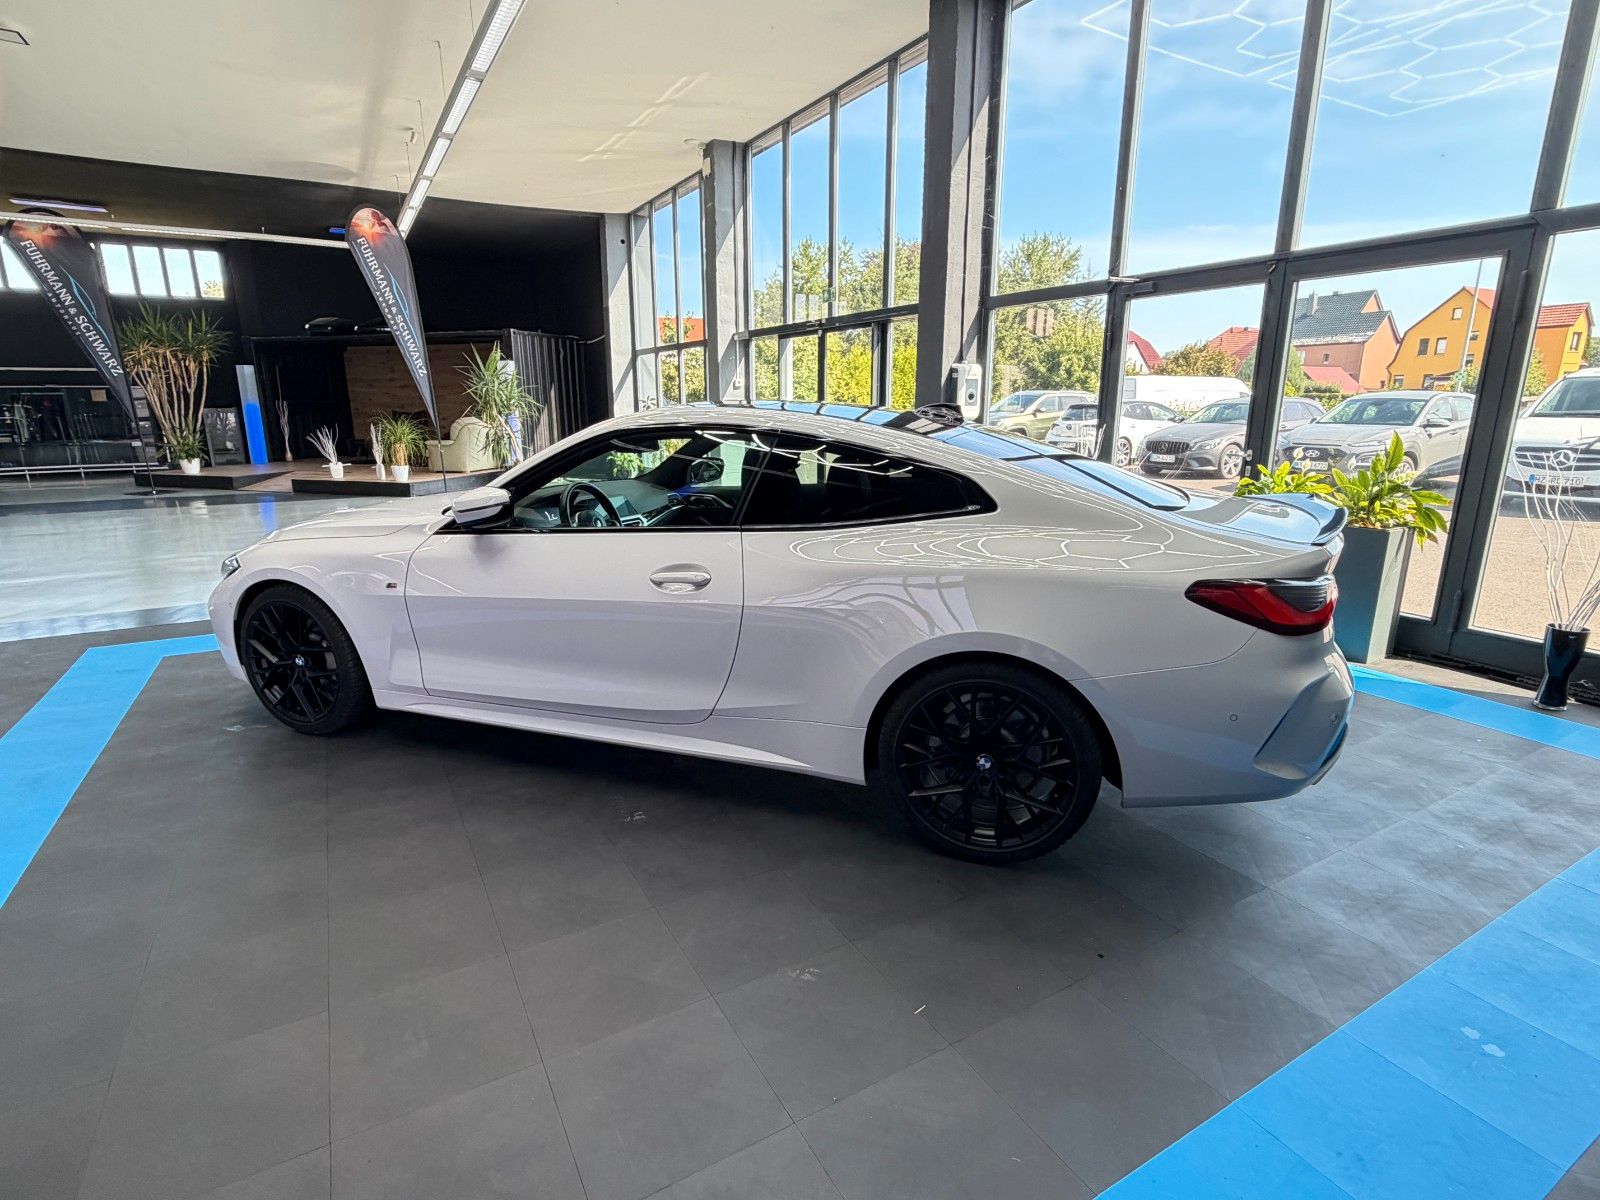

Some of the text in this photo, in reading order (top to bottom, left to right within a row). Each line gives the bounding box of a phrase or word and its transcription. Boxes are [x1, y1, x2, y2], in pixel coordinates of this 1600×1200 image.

[20, 239, 125, 377] FUHRMANN & SCHWARZ
[357, 236, 428, 377] FUHRMANN & SCHWARZ
